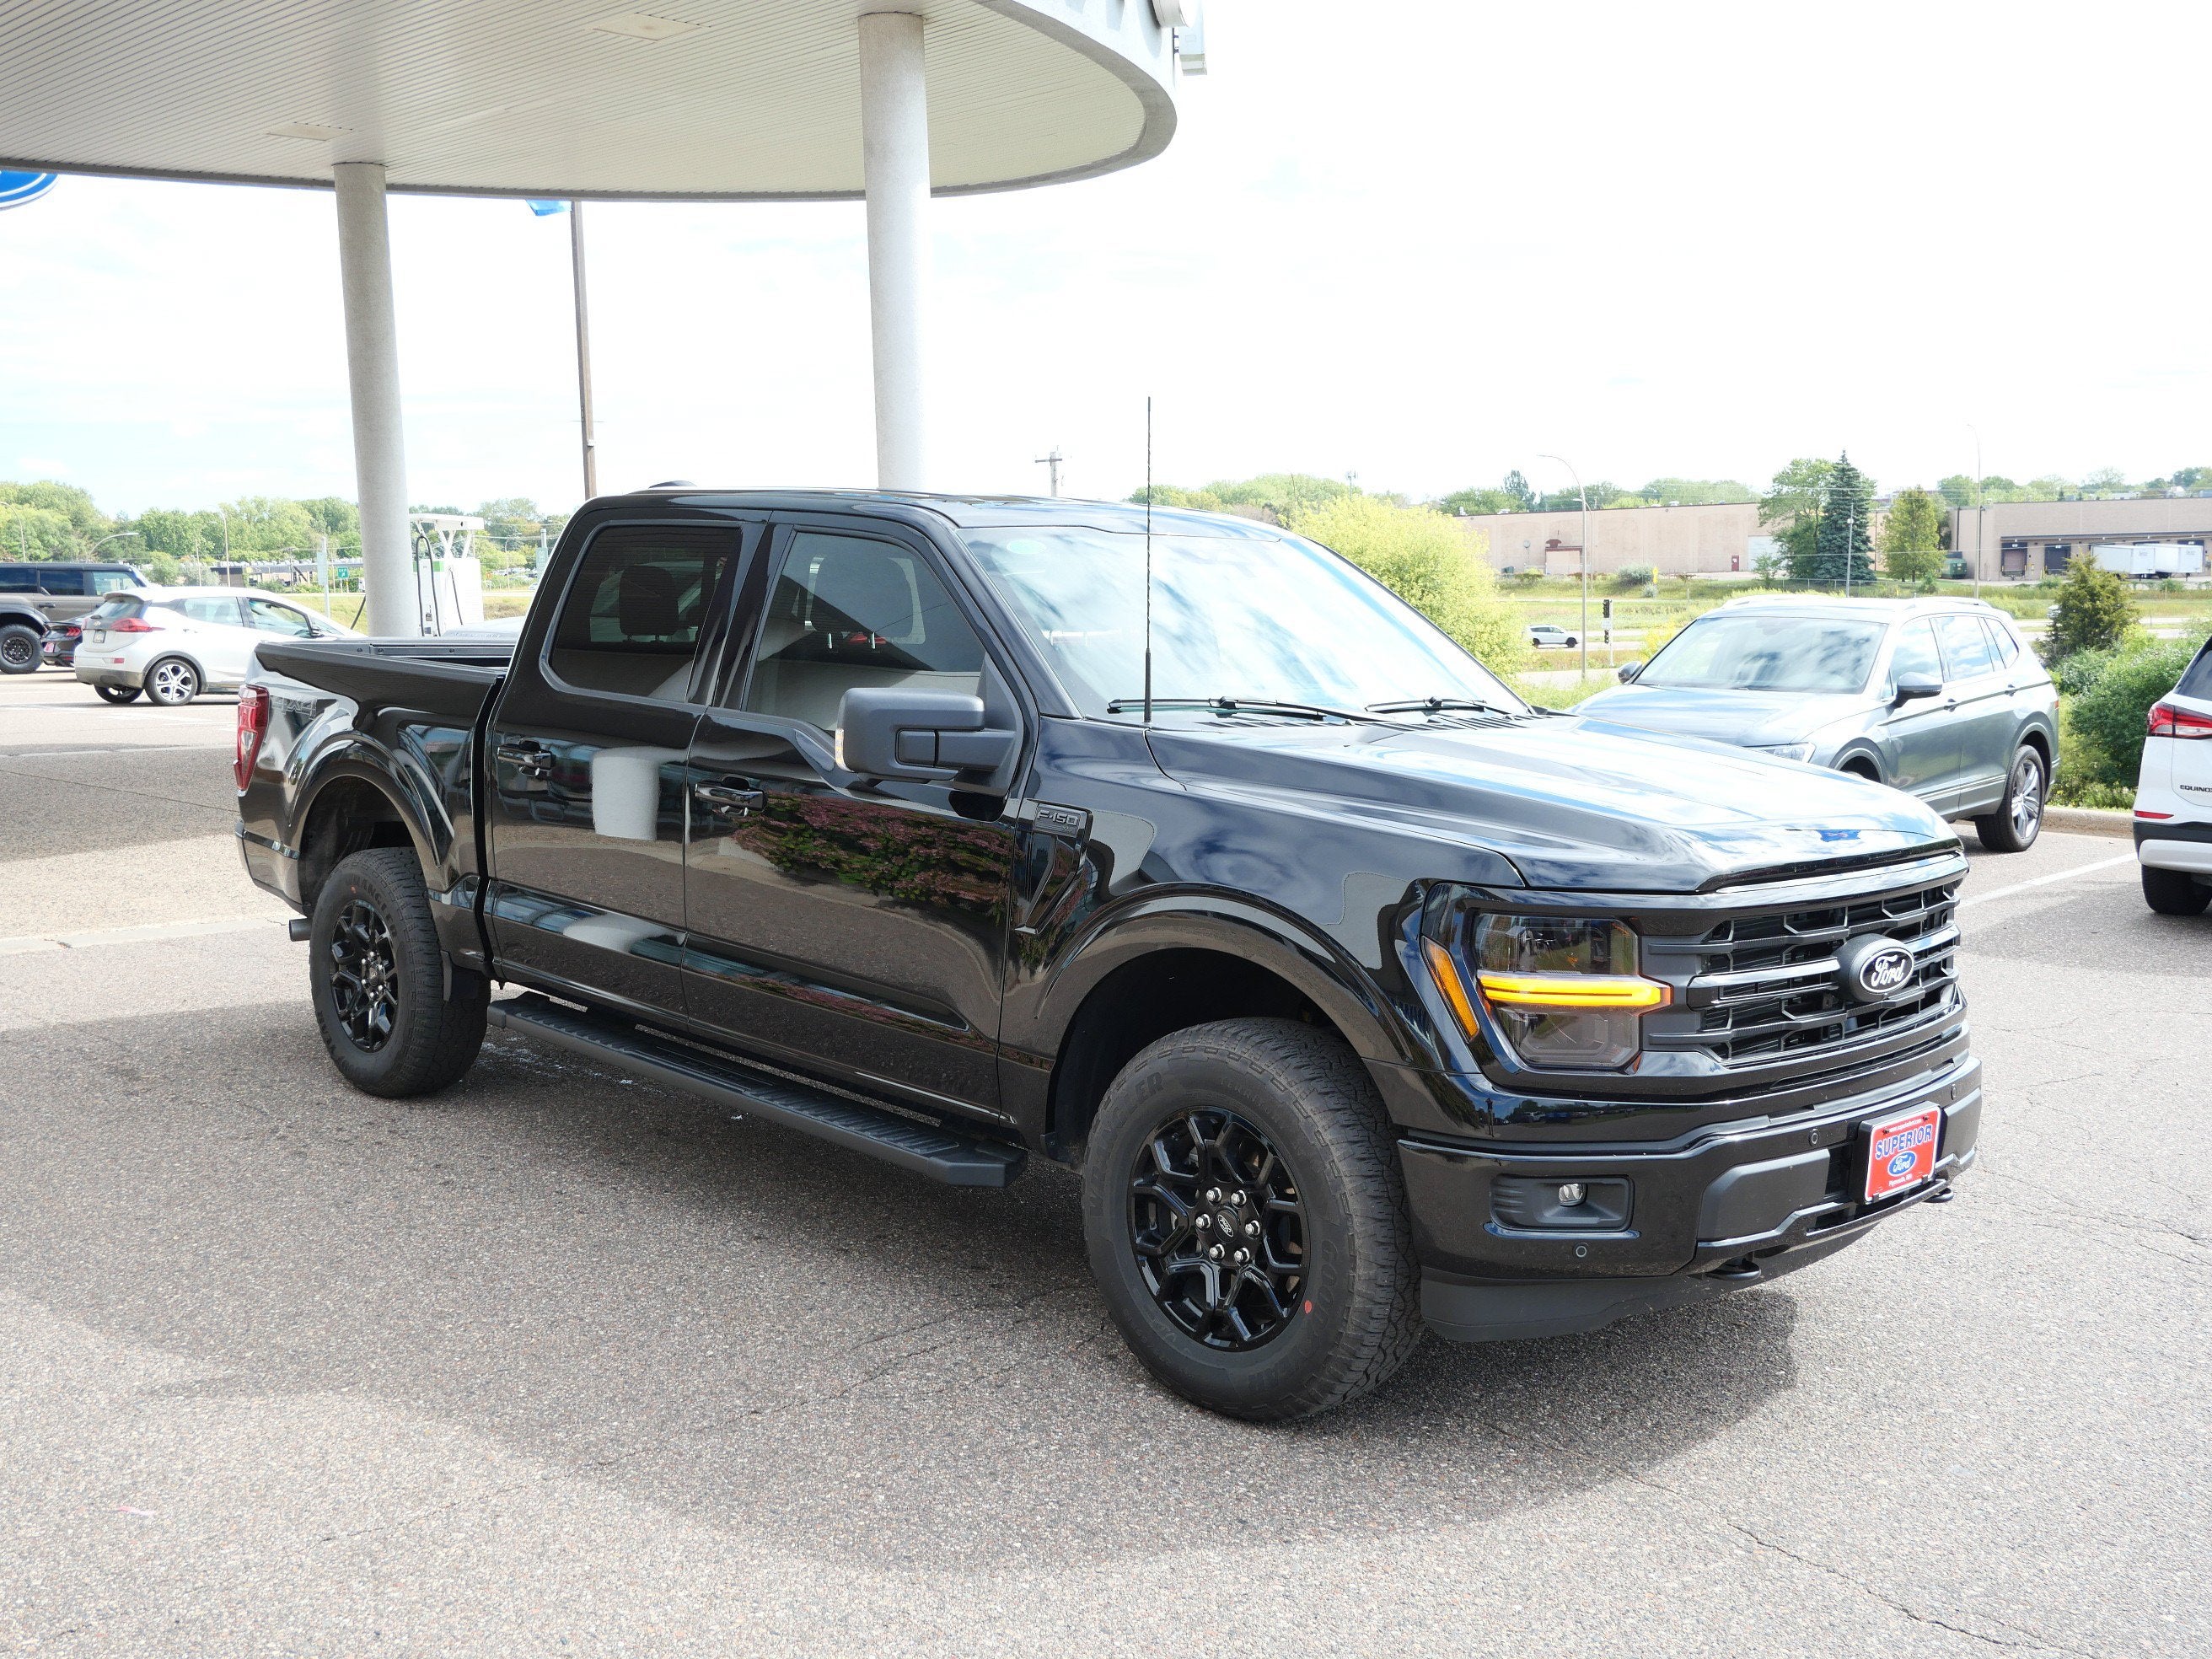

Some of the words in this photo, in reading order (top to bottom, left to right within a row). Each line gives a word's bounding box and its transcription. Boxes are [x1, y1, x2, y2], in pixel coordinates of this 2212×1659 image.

[271, 697, 318, 721] 4x4
[1037, 809, 1078, 826] F-150
[1871, 954, 1906, 987] Ford
[1875, 1124, 1933, 1160] SUPERIOR
